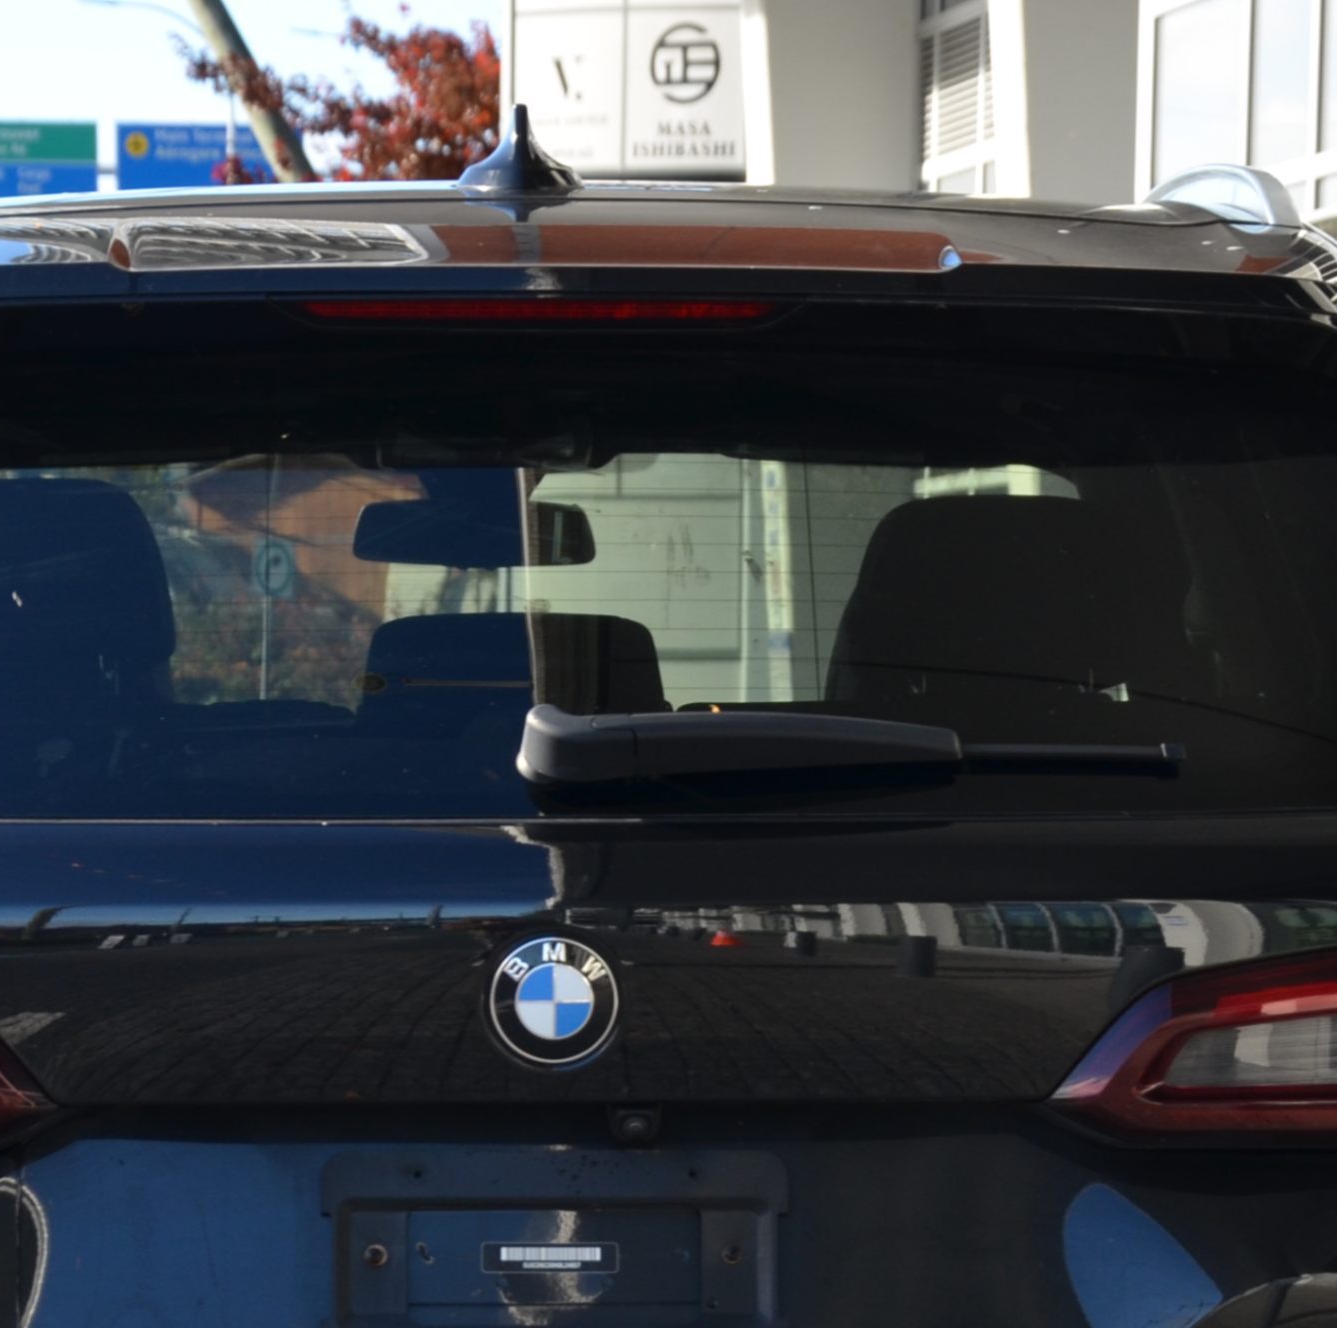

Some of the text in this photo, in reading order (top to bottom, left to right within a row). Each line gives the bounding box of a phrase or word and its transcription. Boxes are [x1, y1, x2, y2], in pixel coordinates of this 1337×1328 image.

[658, 121, 711, 135] MASA
[633, 141, 736, 156] ISHIBASHI
[503, 942, 606, 981] BMW
